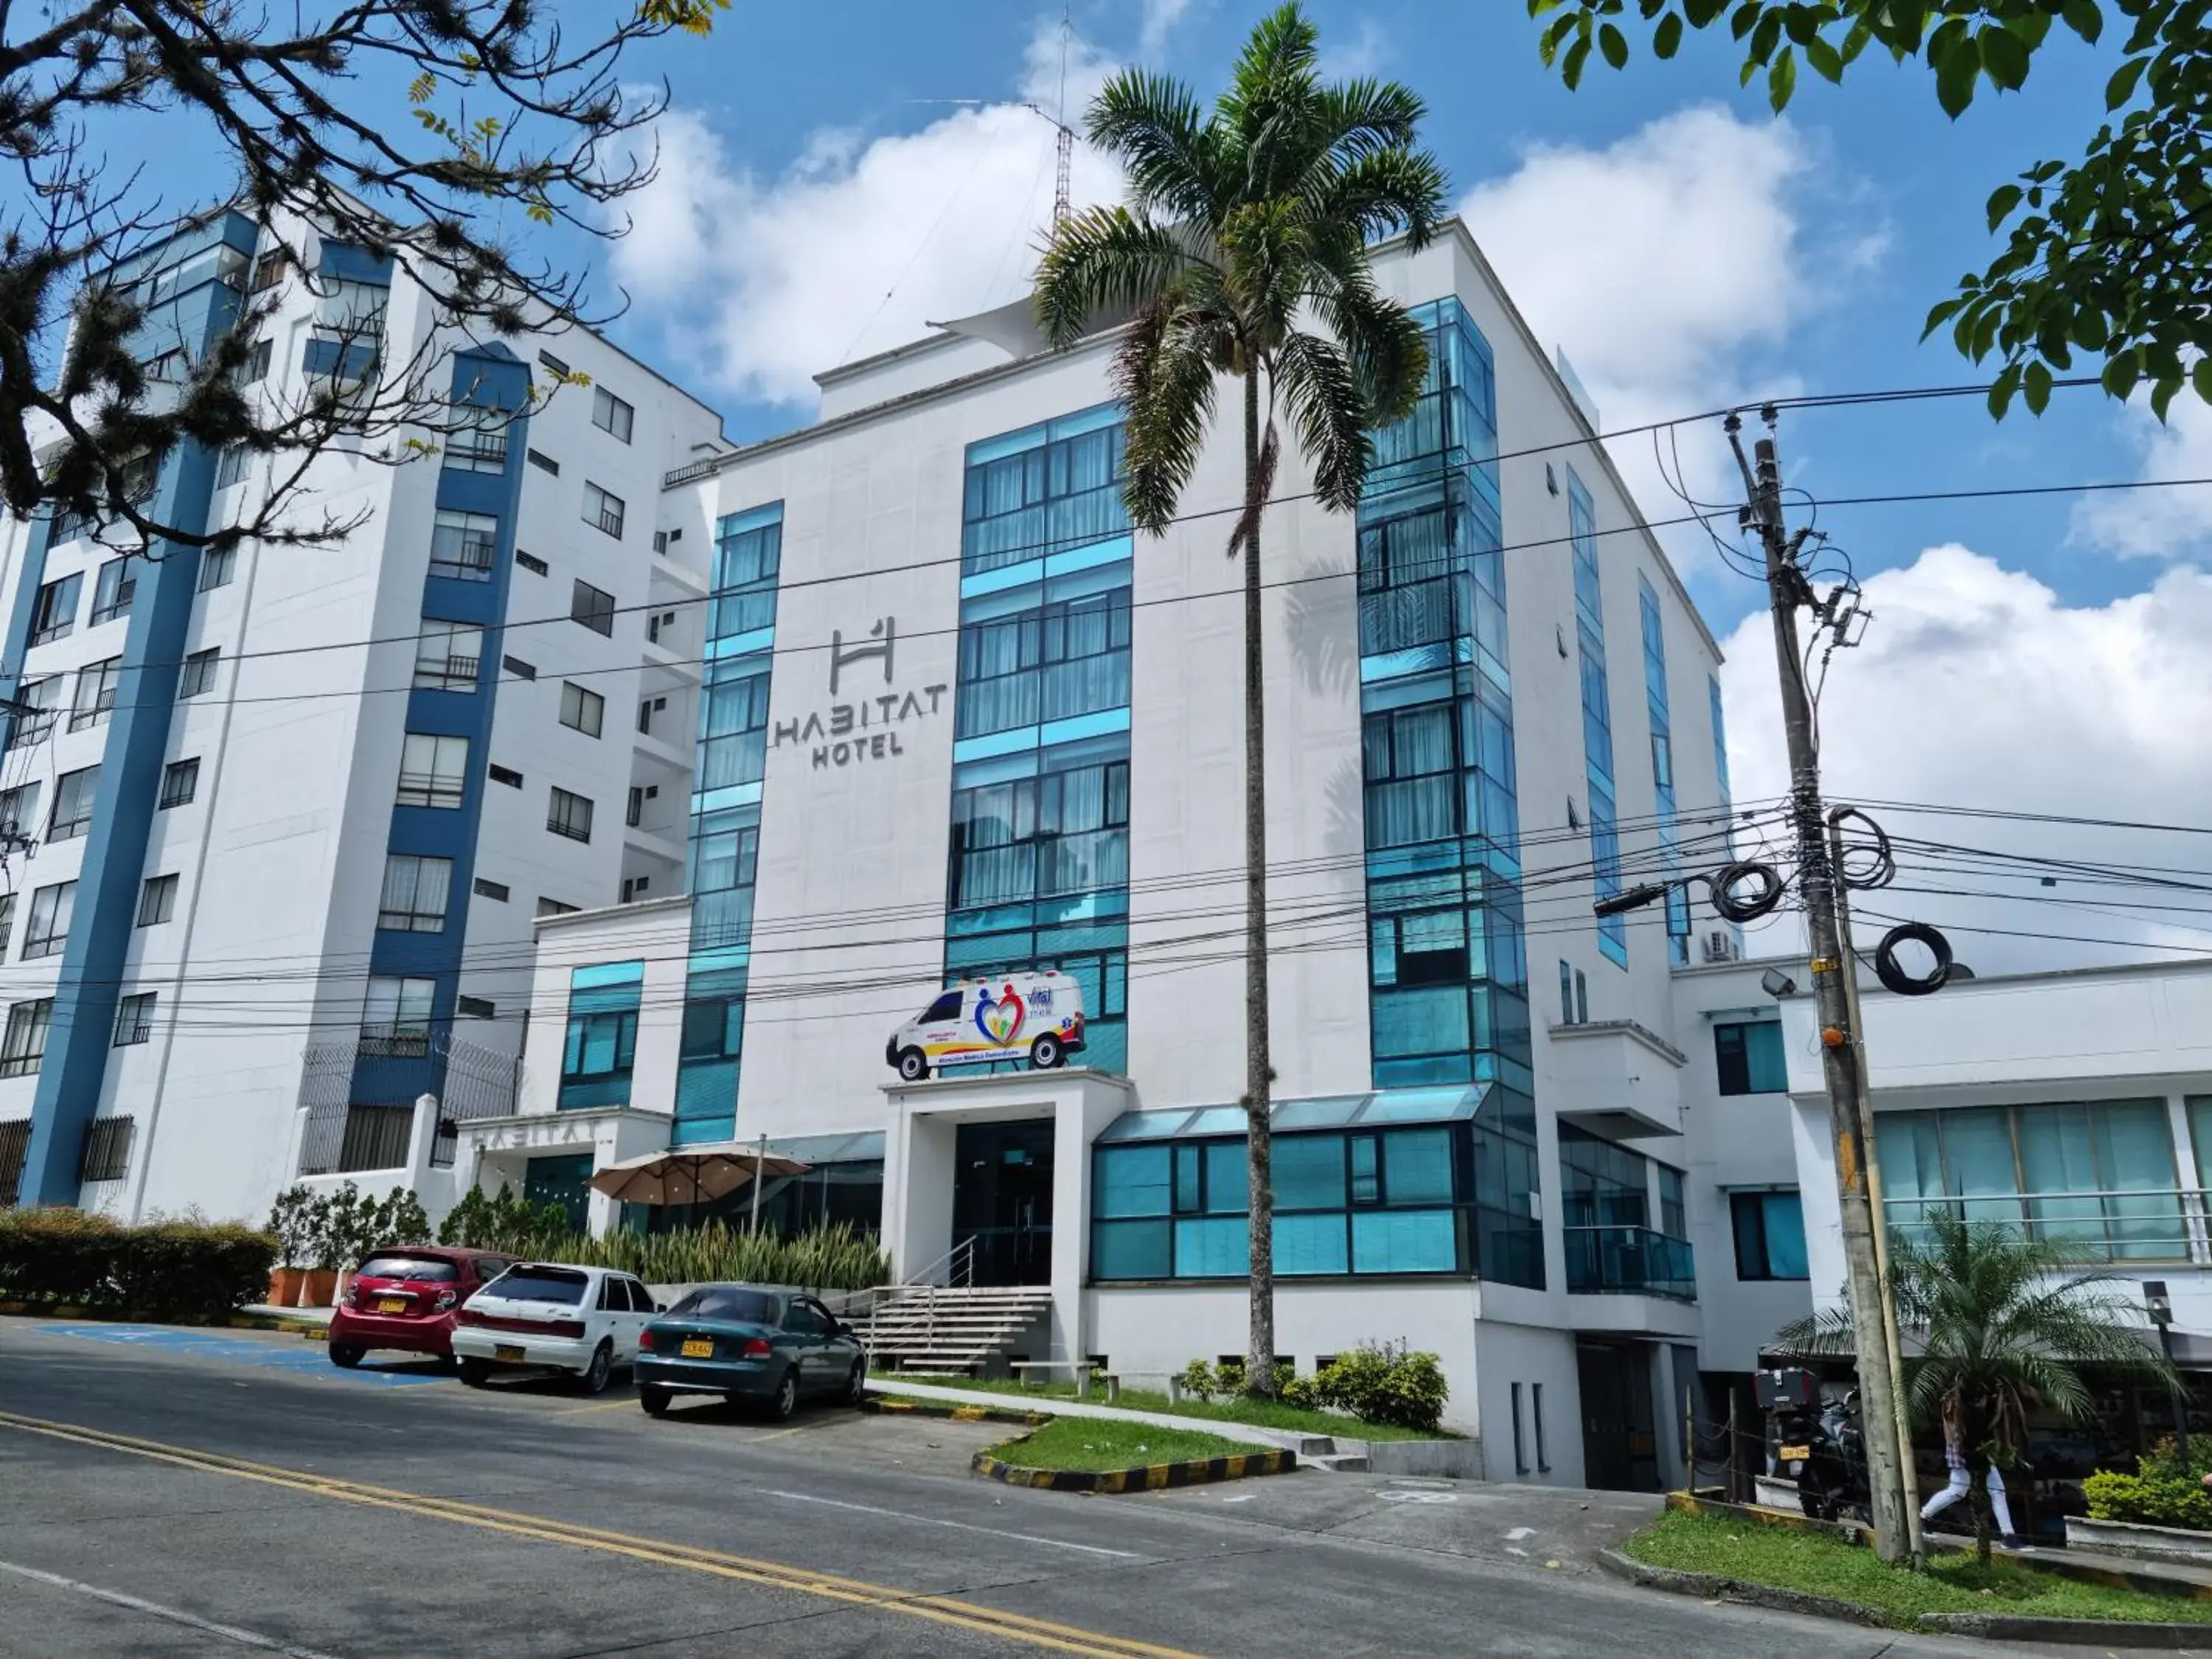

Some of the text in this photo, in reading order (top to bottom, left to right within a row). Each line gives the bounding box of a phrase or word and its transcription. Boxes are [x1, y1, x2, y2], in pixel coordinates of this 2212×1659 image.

[775, 684, 947, 748] HABITAT
[812, 731, 903, 770] HOTEL
[471, 1119, 600, 1148] HABITAT
